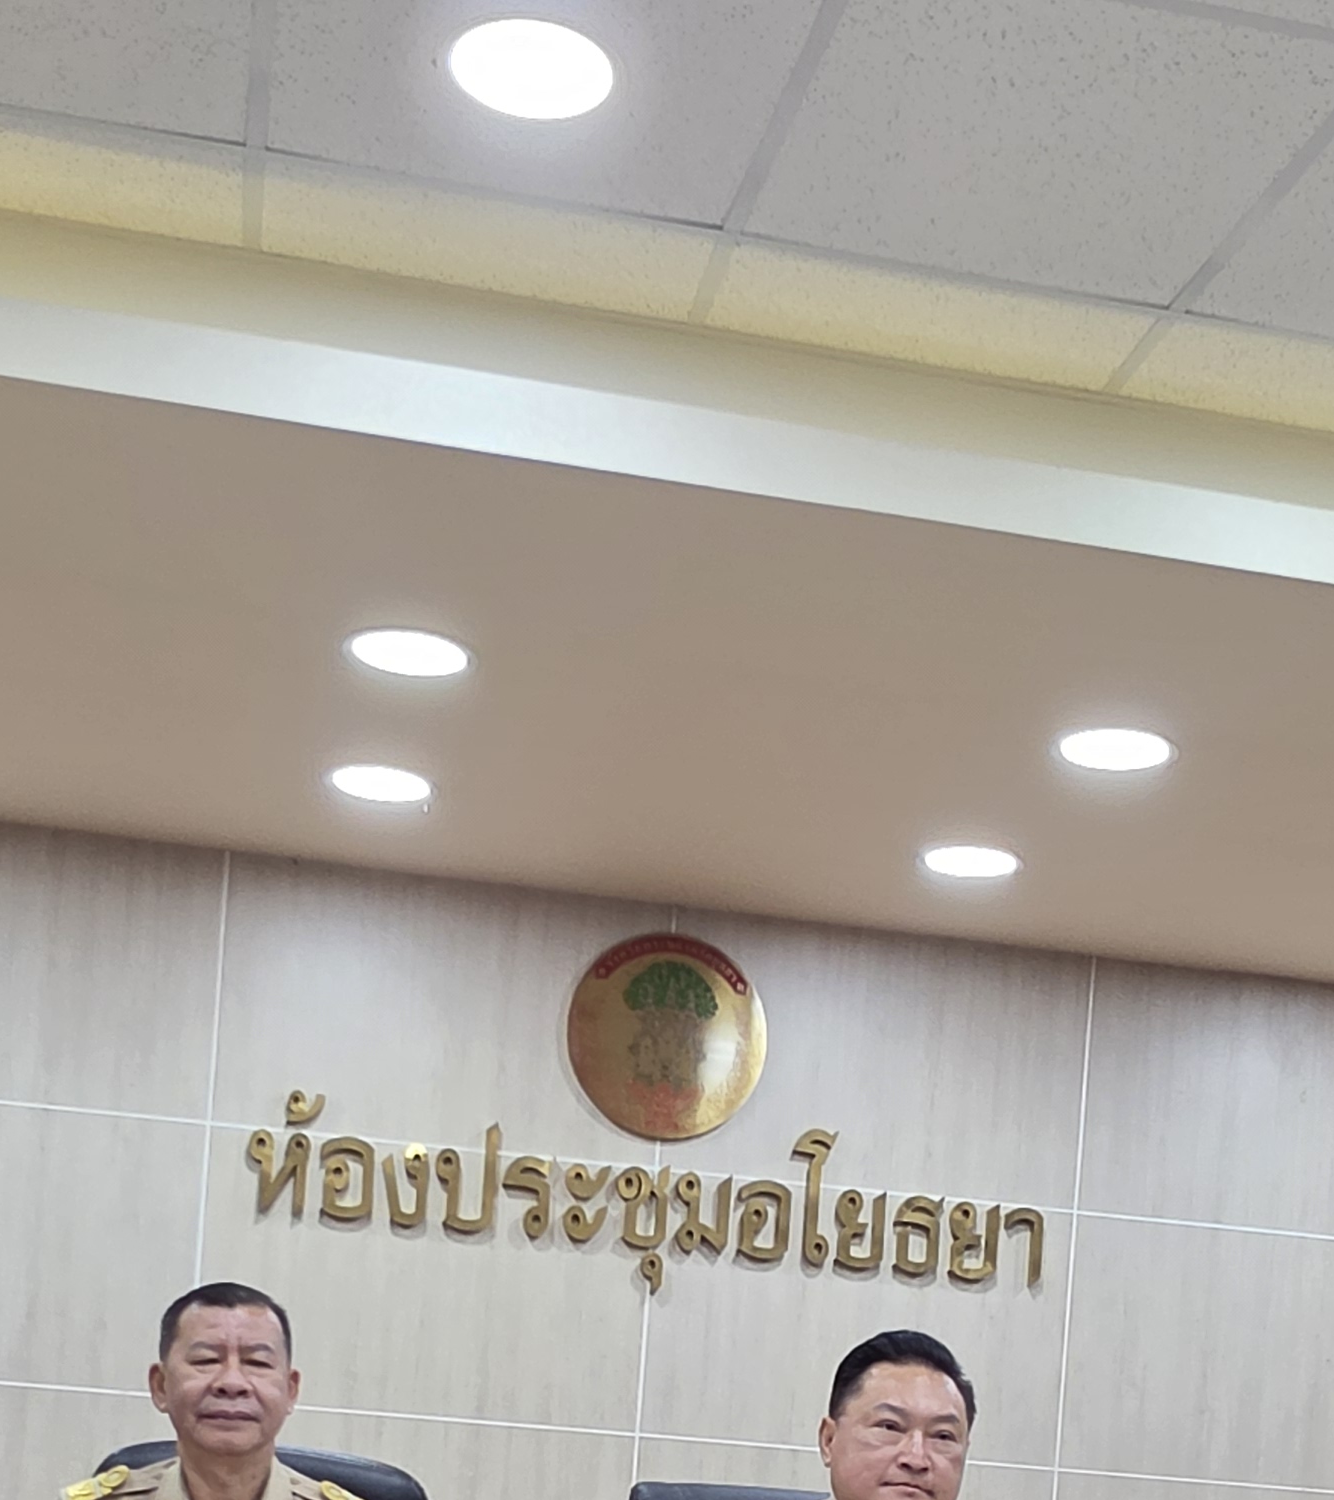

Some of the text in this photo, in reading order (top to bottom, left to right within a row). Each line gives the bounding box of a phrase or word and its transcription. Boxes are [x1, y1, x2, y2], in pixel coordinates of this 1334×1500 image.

[246, 1090, 1044, 1294] ห้องประชุมอโยธยา
